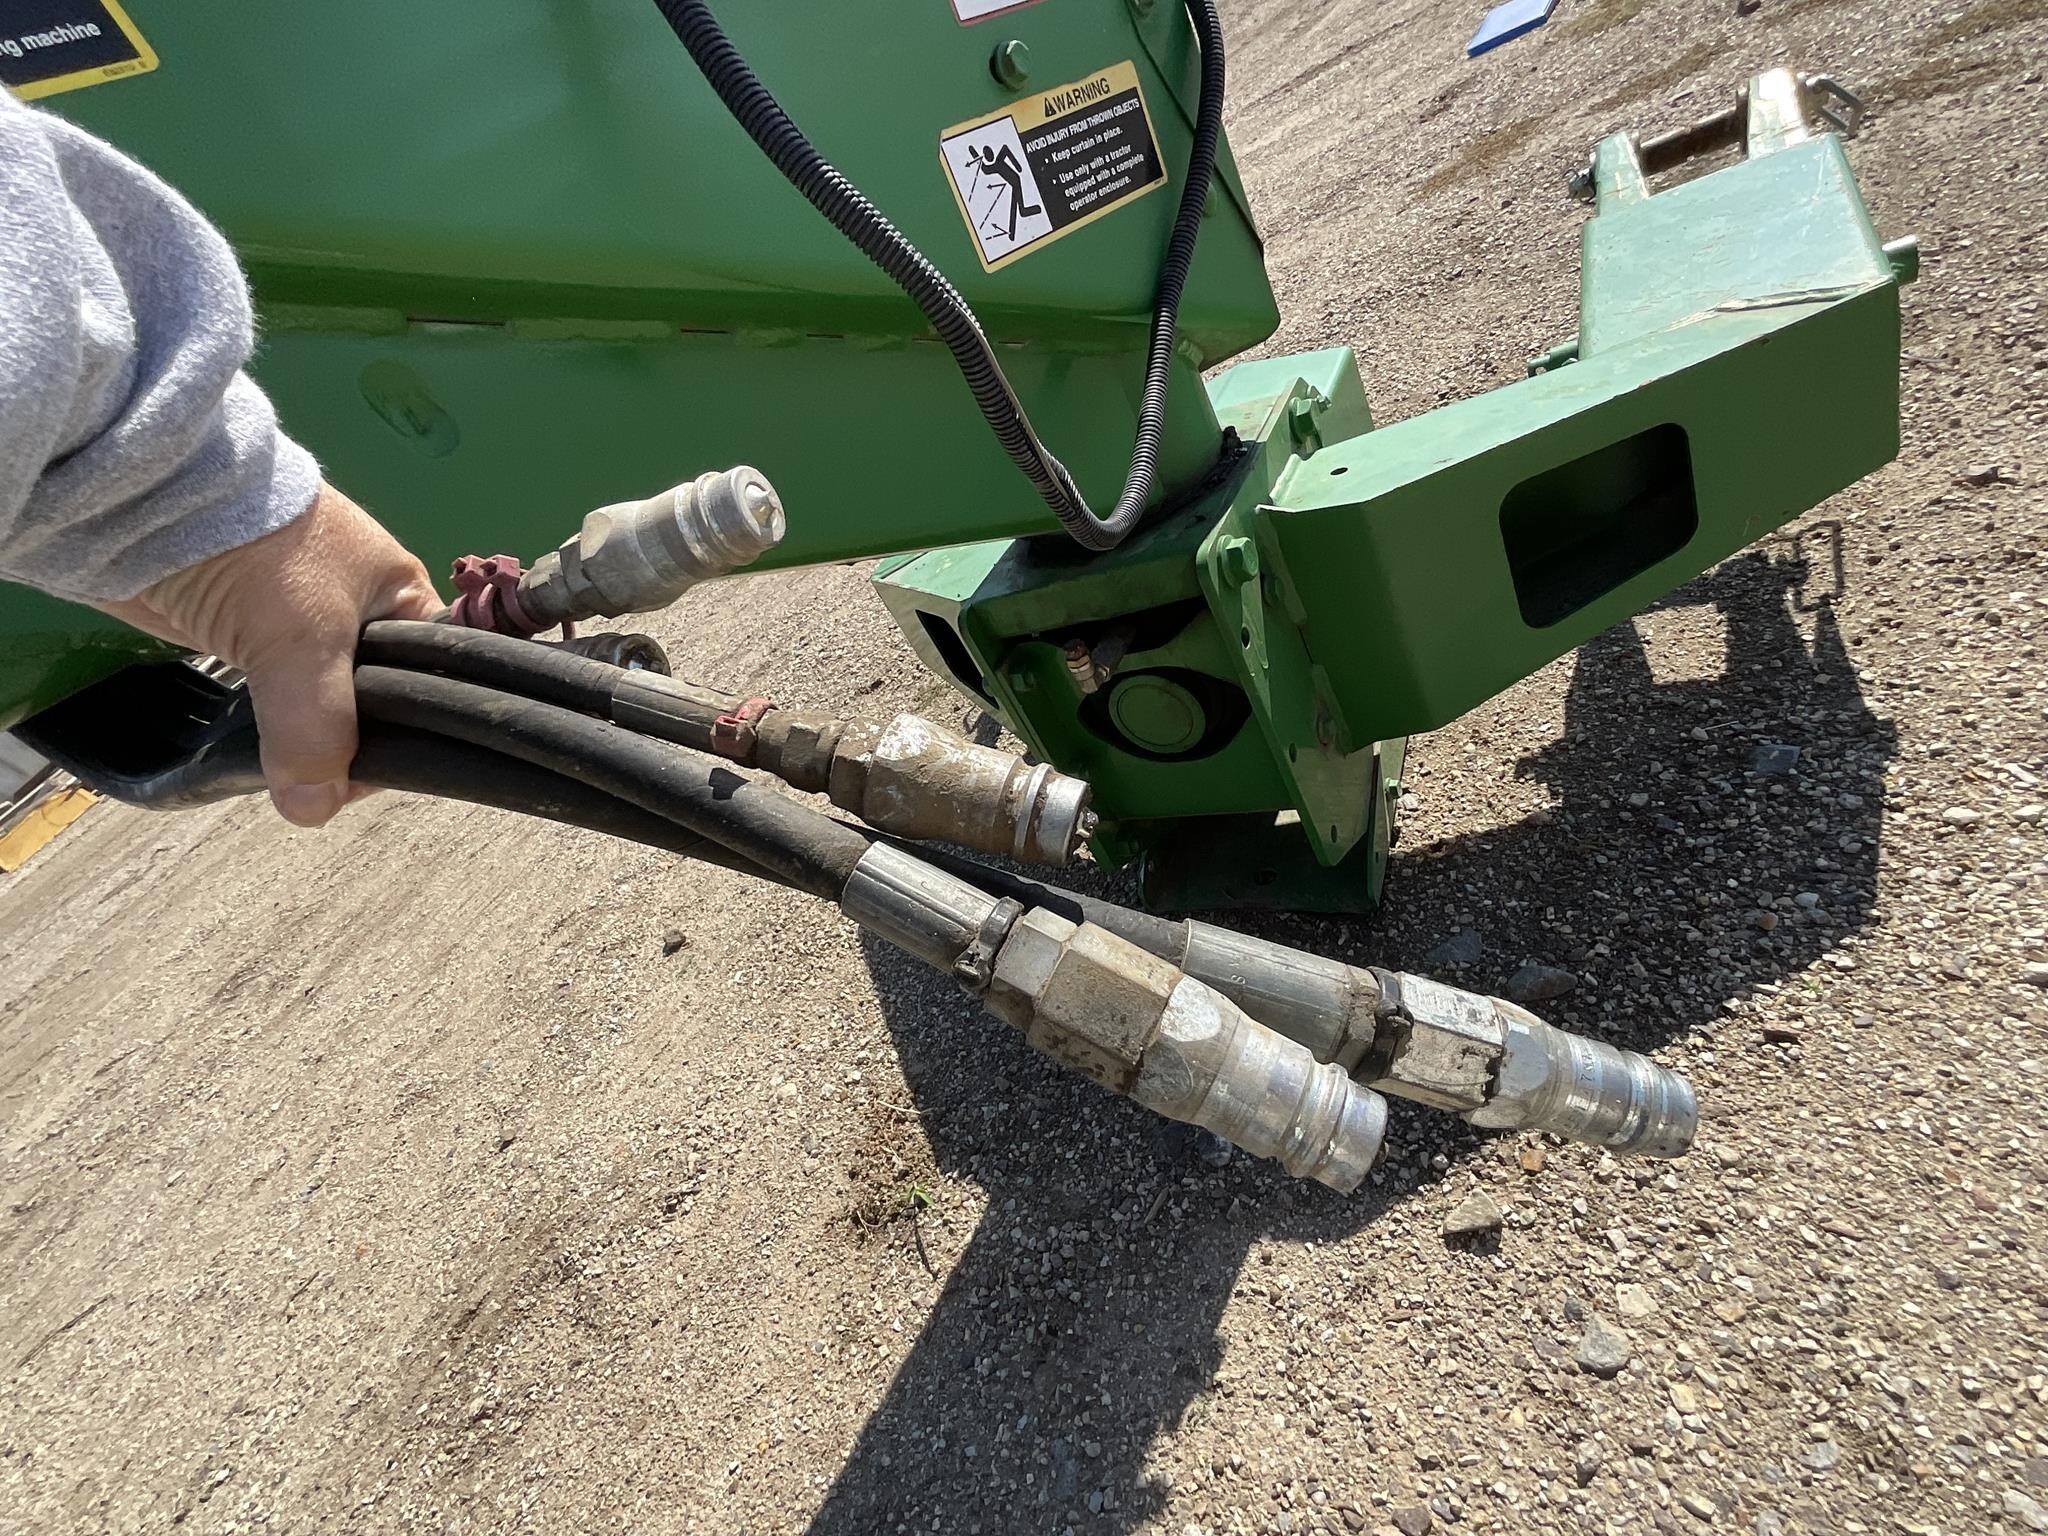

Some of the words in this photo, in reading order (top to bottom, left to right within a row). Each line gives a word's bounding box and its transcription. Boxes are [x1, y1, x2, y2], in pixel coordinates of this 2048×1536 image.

[20, 23, 101, 50] machine
[1053, 78, 1110, 112] WARNING
[1026, 137, 1047, 153] AVOID
[1046, 128, 1070, 145] INJURY
[1069, 120, 1087, 136] FROM
[1087, 110, 1114, 127] THROWN
[1113, 98, 1140, 116] OBJECTS
[1052, 149, 1071, 162] Keep
[1071, 137, 1095, 154] curtain
[1095, 134, 1103, 144] in
[1103, 126, 1123, 143] place.
[1059, 172, 1074, 183] Use
[1074, 163, 1089, 175] only
[1090, 156, 1105, 169] with
[1105, 154, 1110, 163] a
[1110, 144, 1131, 160] tractor
[1064, 175, 1096, 197] equipped
[1095, 169, 1111, 182] with
[1111, 167, 1116, 176] a
[1116, 153, 1144, 173] complete
[1069, 191, 1098, 211] operator
[1098, 176, 1131, 197] enclosure.
